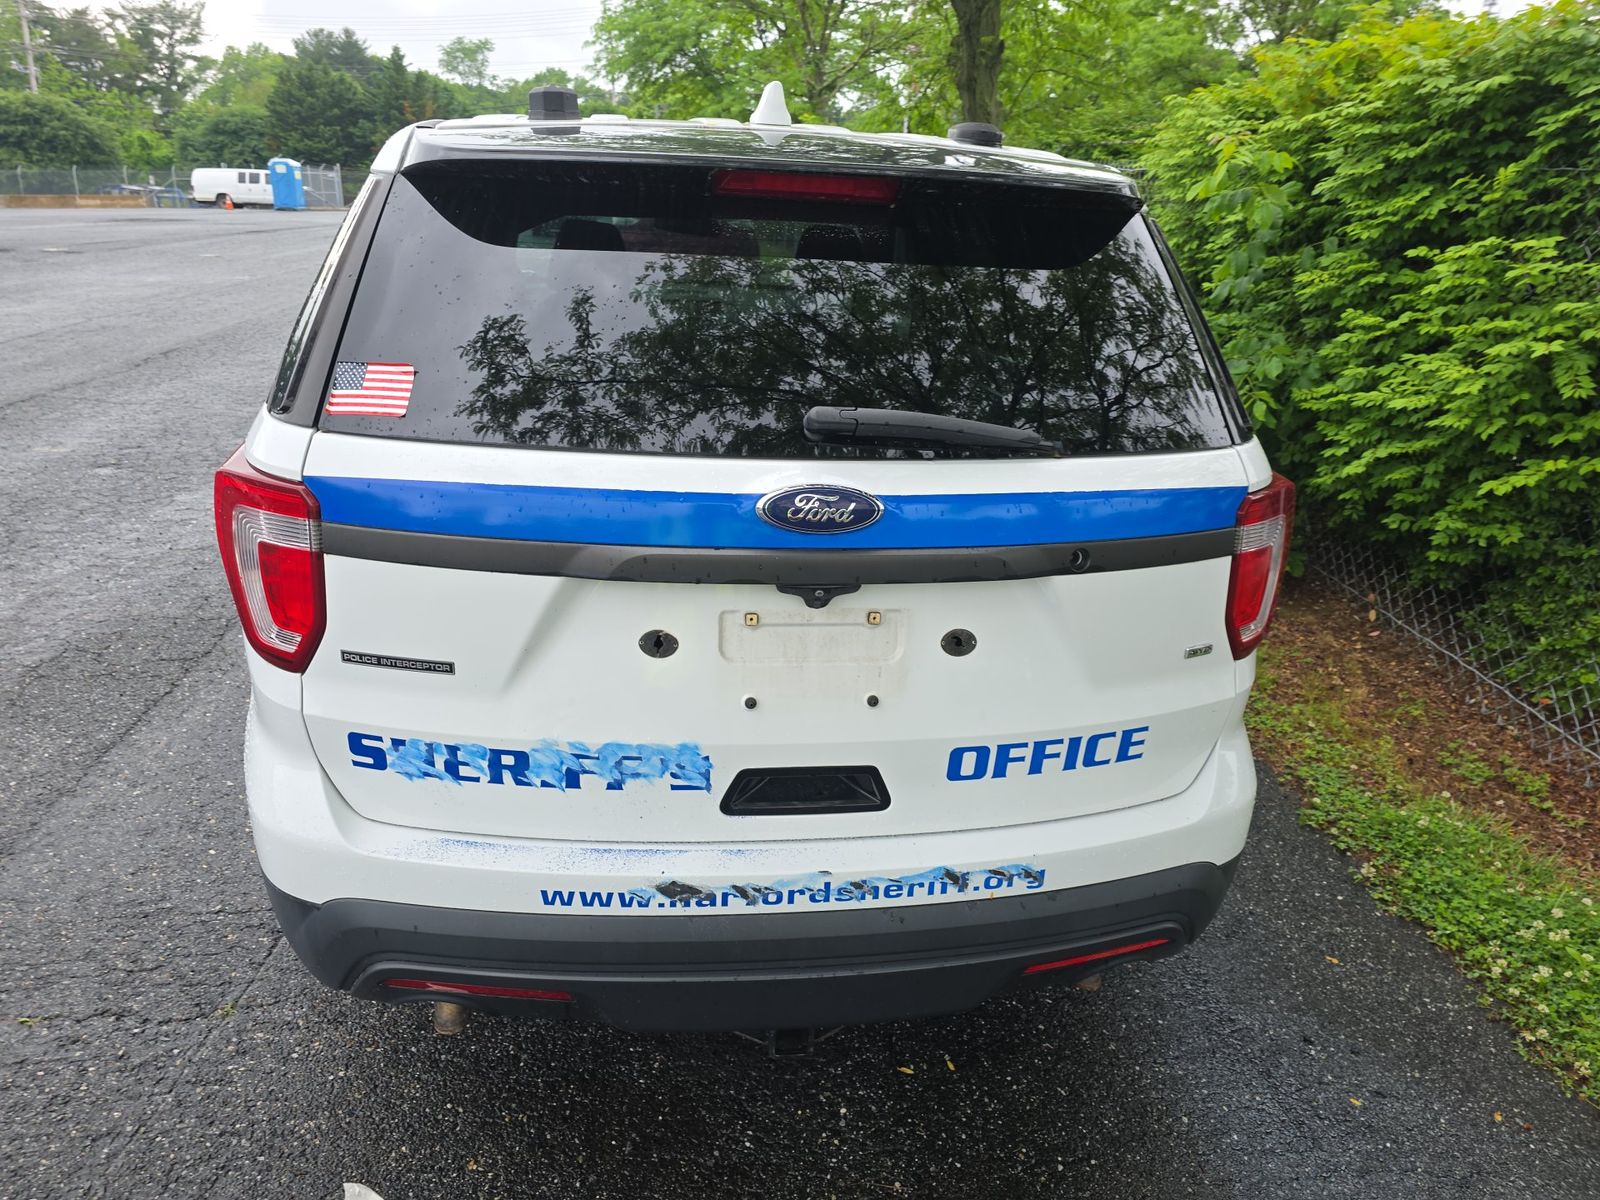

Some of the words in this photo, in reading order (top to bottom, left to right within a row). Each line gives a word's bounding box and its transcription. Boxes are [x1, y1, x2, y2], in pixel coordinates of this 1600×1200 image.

[787, 493, 857, 523] Ford
[343, 653, 378, 664] POLICE
[380, 658, 451, 672] INTERCEPTOR
[946, 726, 1149, 782] OFFICE
